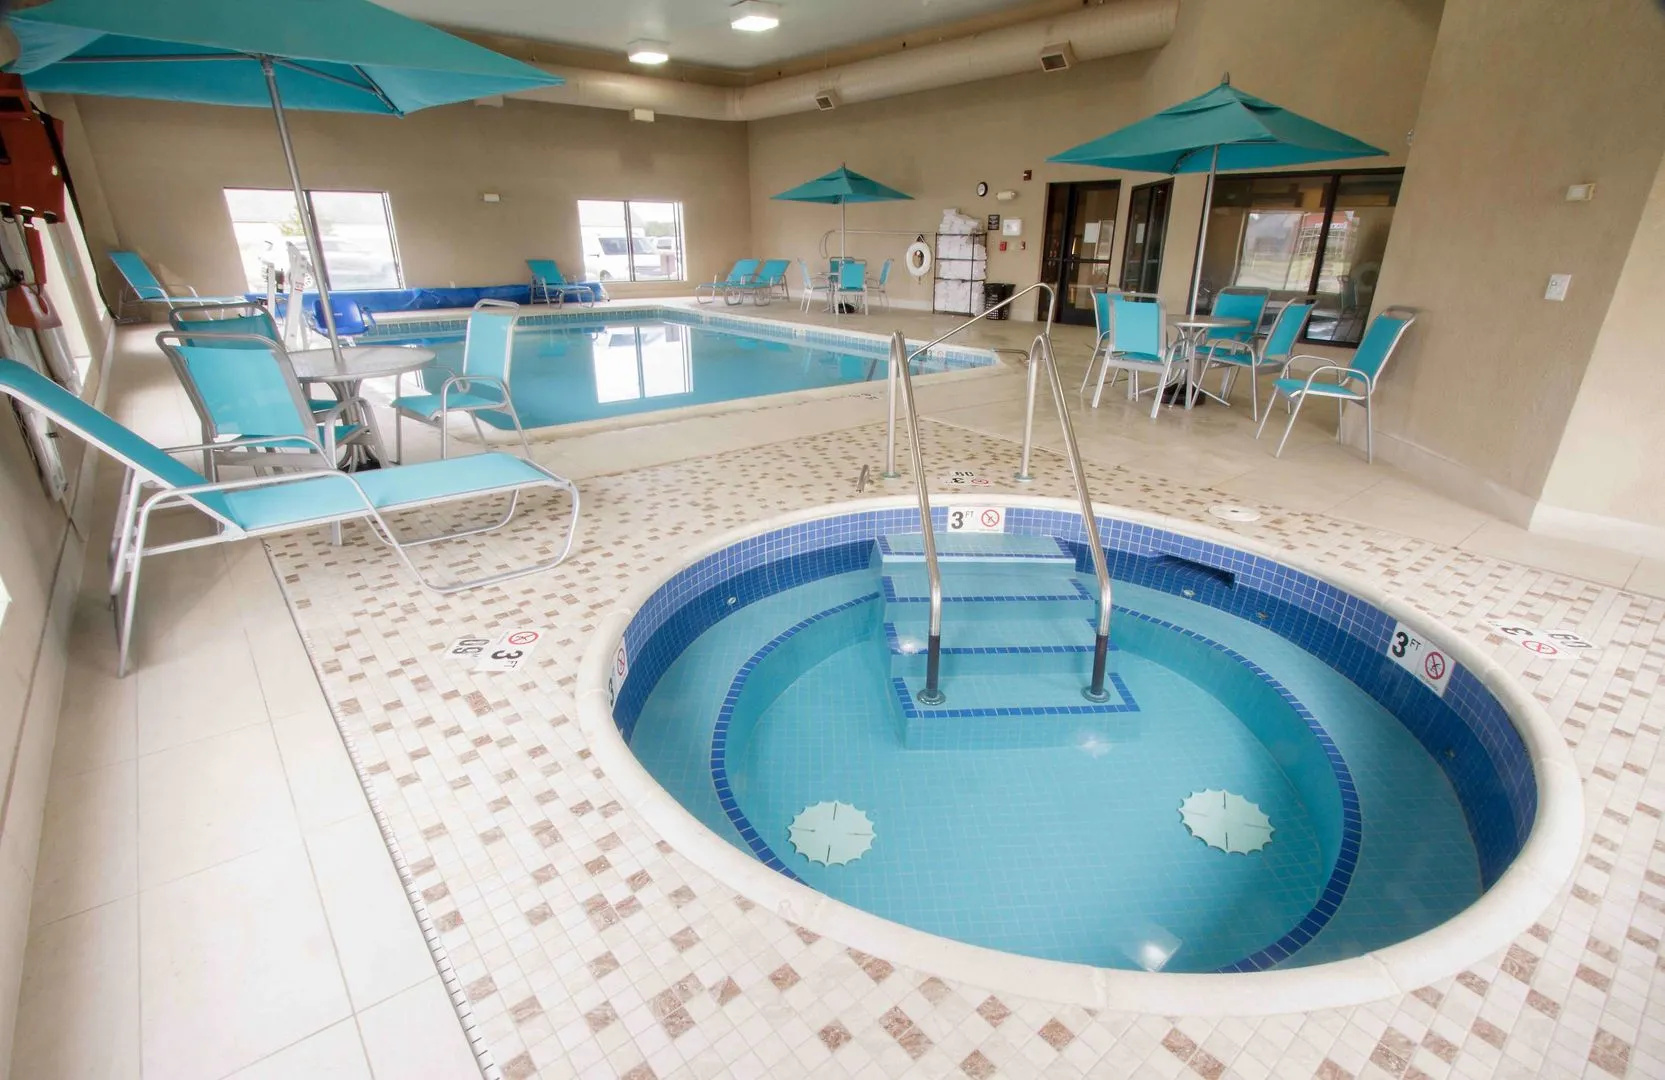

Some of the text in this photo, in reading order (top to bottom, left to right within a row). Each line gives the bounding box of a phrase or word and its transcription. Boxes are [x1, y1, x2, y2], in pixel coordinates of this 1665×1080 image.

[951, 510, 974, 529] 3 FT
[1500, 627, 1533, 636] 3
[1392, 631, 1421, 658] 3 FT
[491, 650, 523, 660] 3
